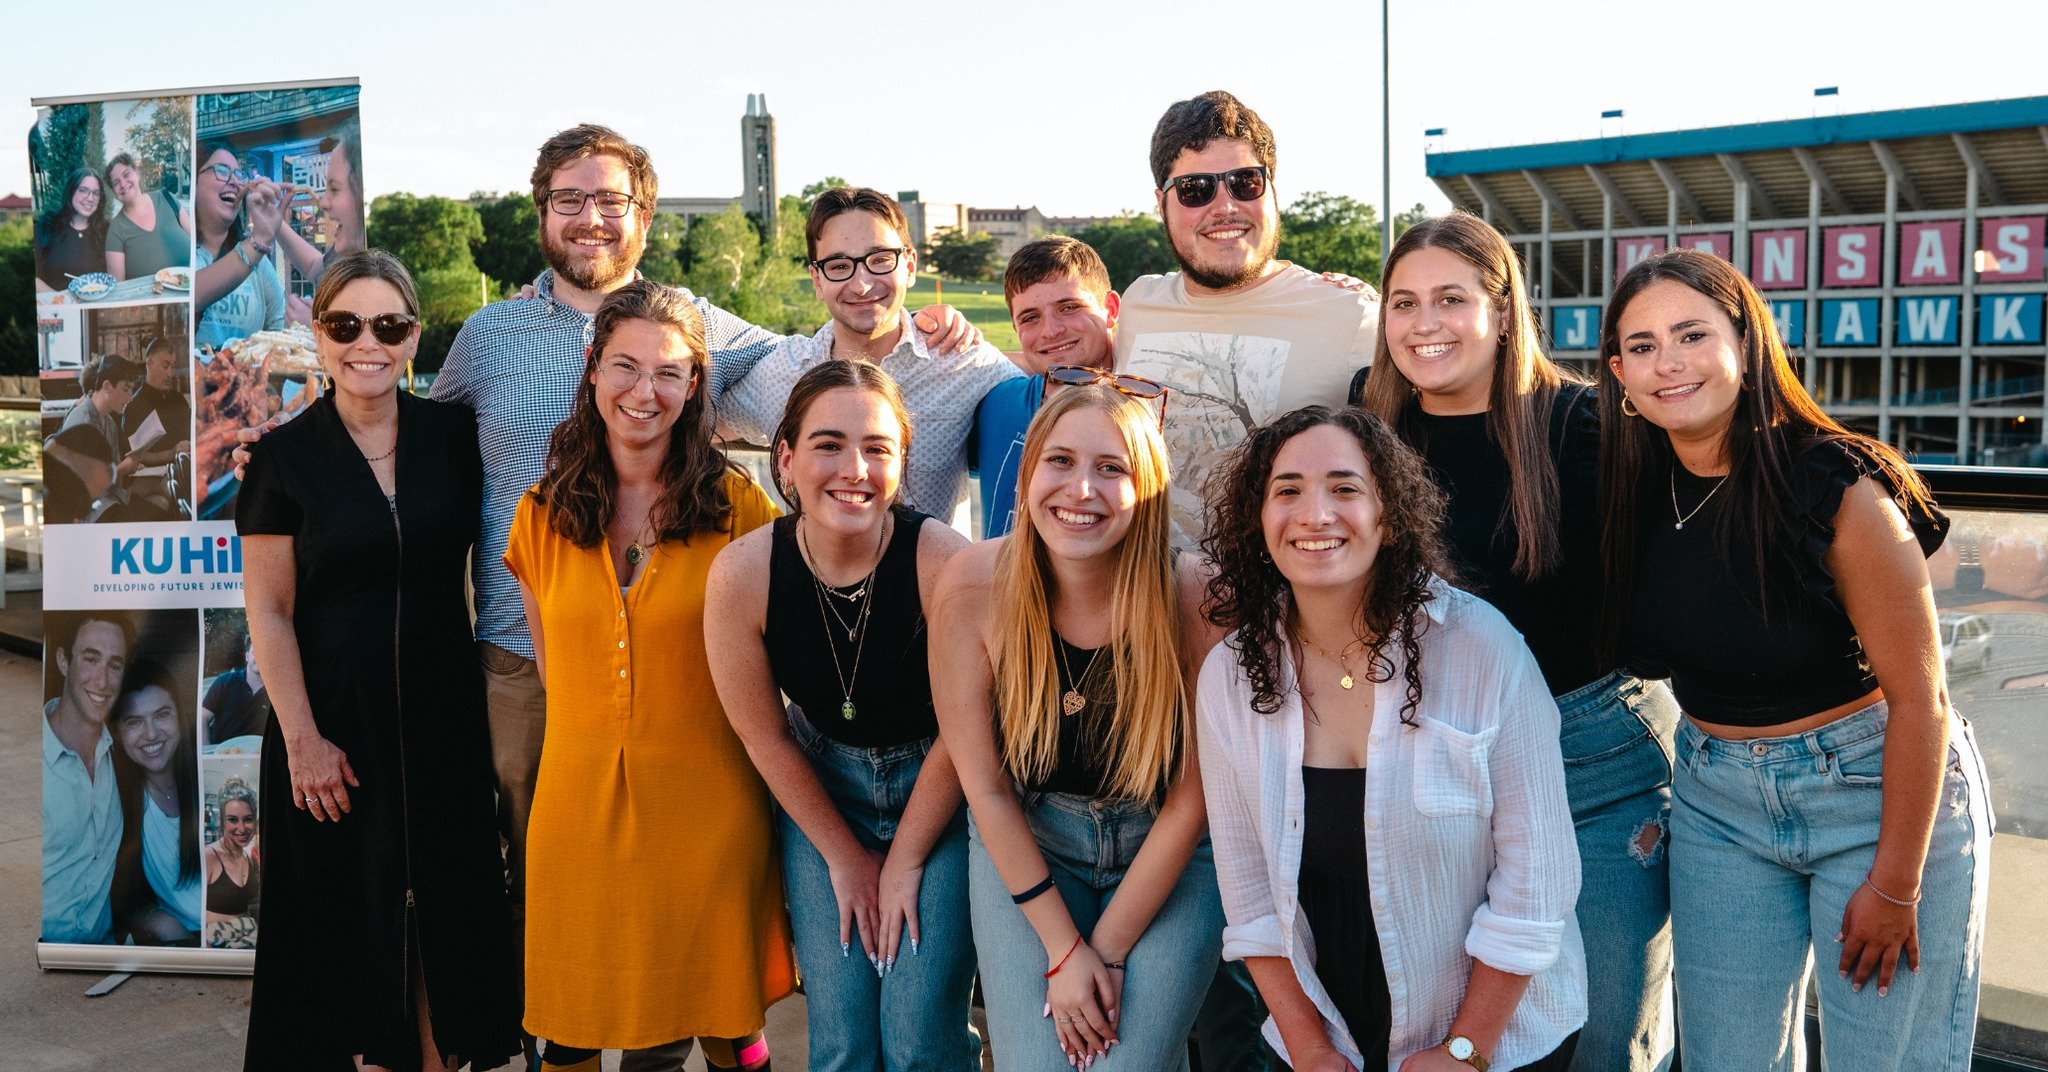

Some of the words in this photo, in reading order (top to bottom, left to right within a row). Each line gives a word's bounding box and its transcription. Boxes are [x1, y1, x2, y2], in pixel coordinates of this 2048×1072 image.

[1626, 224, 2030, 283] KNSAS
[1566, 296, 2027, 346] JHAWK
[93, 583, 155, 592] DEVELOPING
[160, 582, 205, 591] FUTURE
